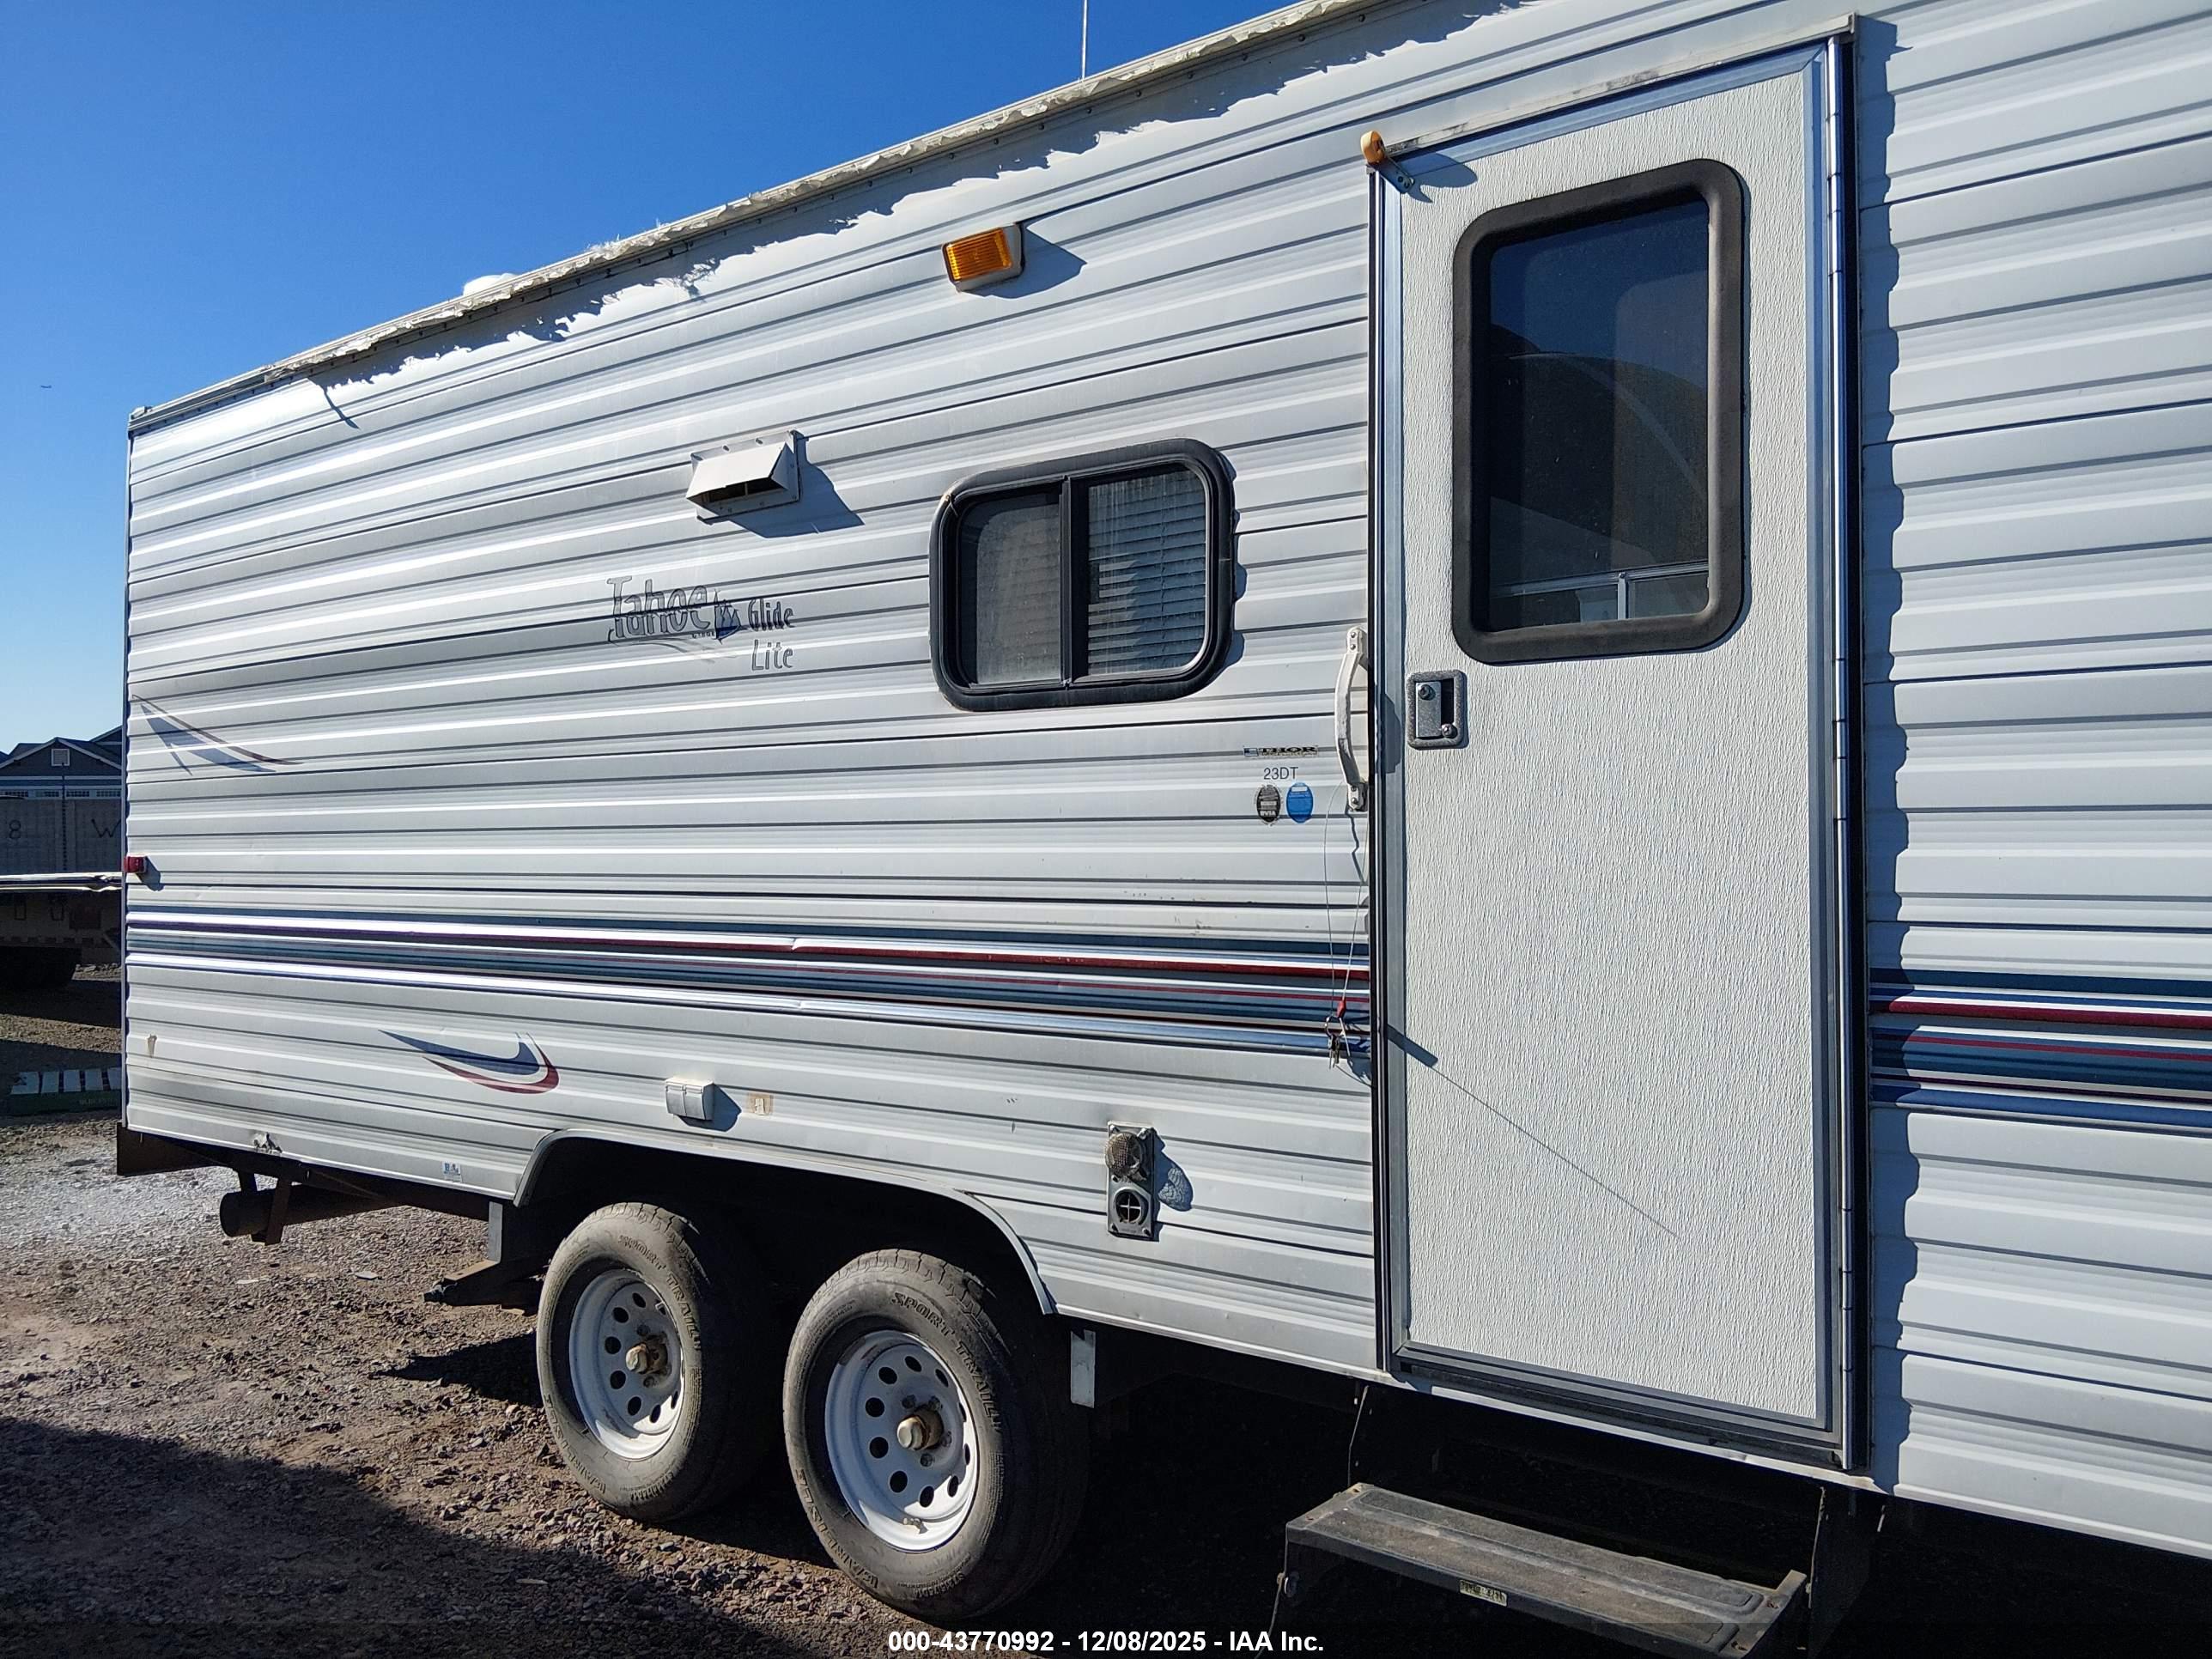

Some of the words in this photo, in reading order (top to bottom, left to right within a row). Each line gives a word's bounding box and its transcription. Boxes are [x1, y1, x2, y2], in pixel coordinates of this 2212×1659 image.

[606, 575, 710, 638] Tahoe
[748, 599, 795, 631] Glide
[751, 638, 794, 671] Lite
[1263, 767, 1299, 780] 23DT
[9, 819, 21, 840] 8
[890, 1291, 956, 1336] SPORT
